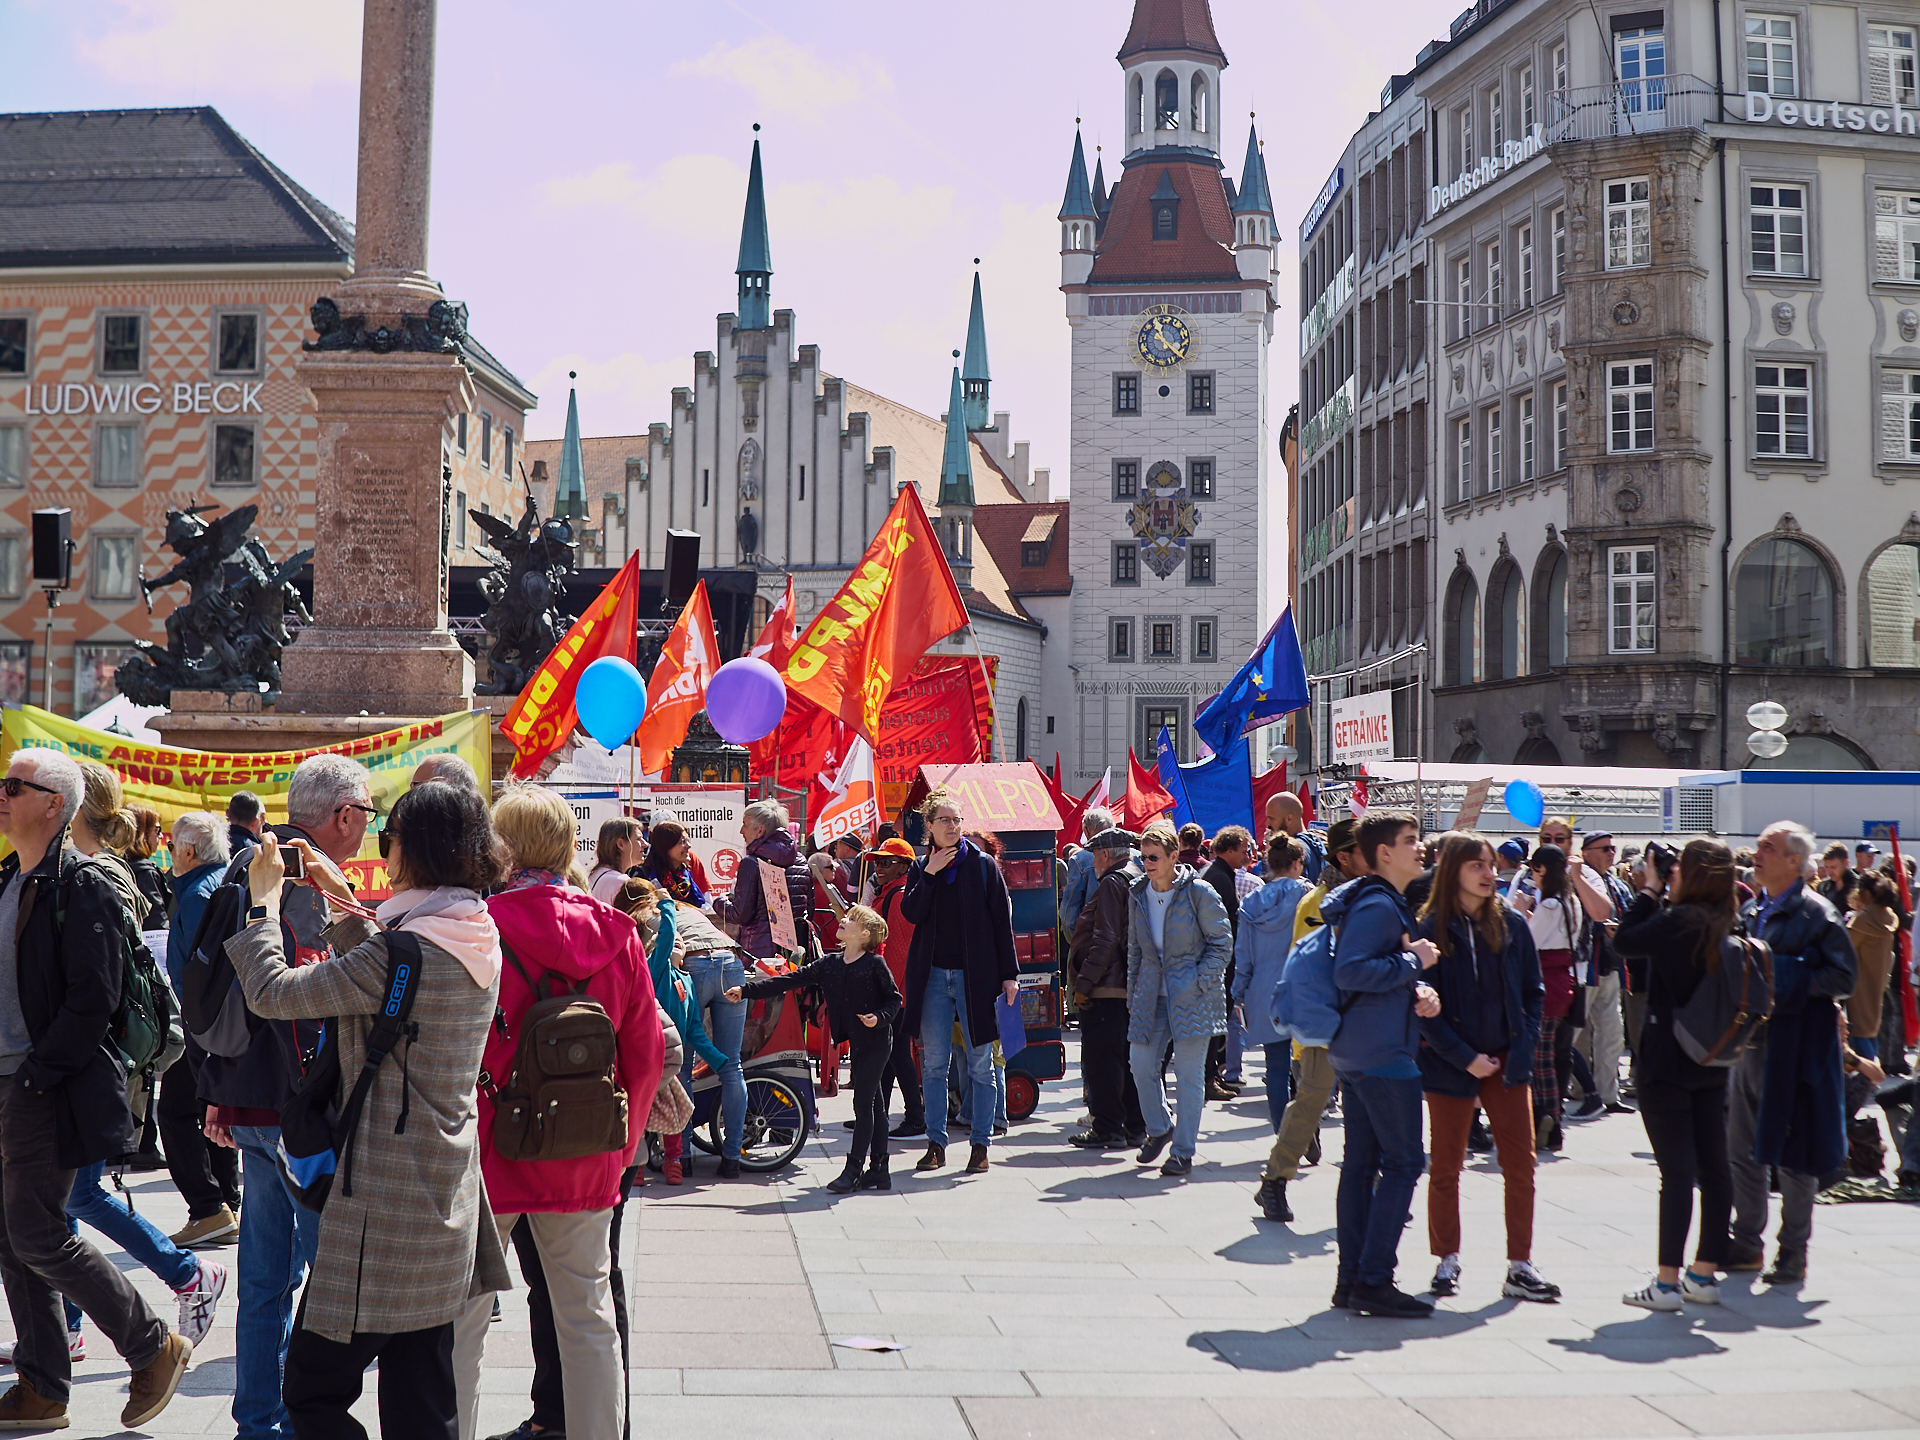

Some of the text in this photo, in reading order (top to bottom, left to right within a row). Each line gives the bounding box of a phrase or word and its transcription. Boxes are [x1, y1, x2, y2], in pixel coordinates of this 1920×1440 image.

[1746, 91, 1920, 135] Deutsch
[1432, 122, 1544, 214] Deutsche Bank
[25, 381, 265, 415] LUDWIG BECK
[66, 741, 104, 760] DIE
[108, 730, 404, 768] ARBEITEREINHEIT
[409, 720, 443, 742] IN
[1334, 710, 1389, 749] GETRÄNKE
[655, 796, 685, 806] Hoch die
[656, 806, 733, 822] rnationale
[938, 779, 1050, 819] MLPD
[385, 964, 410, 1017] OGIO
